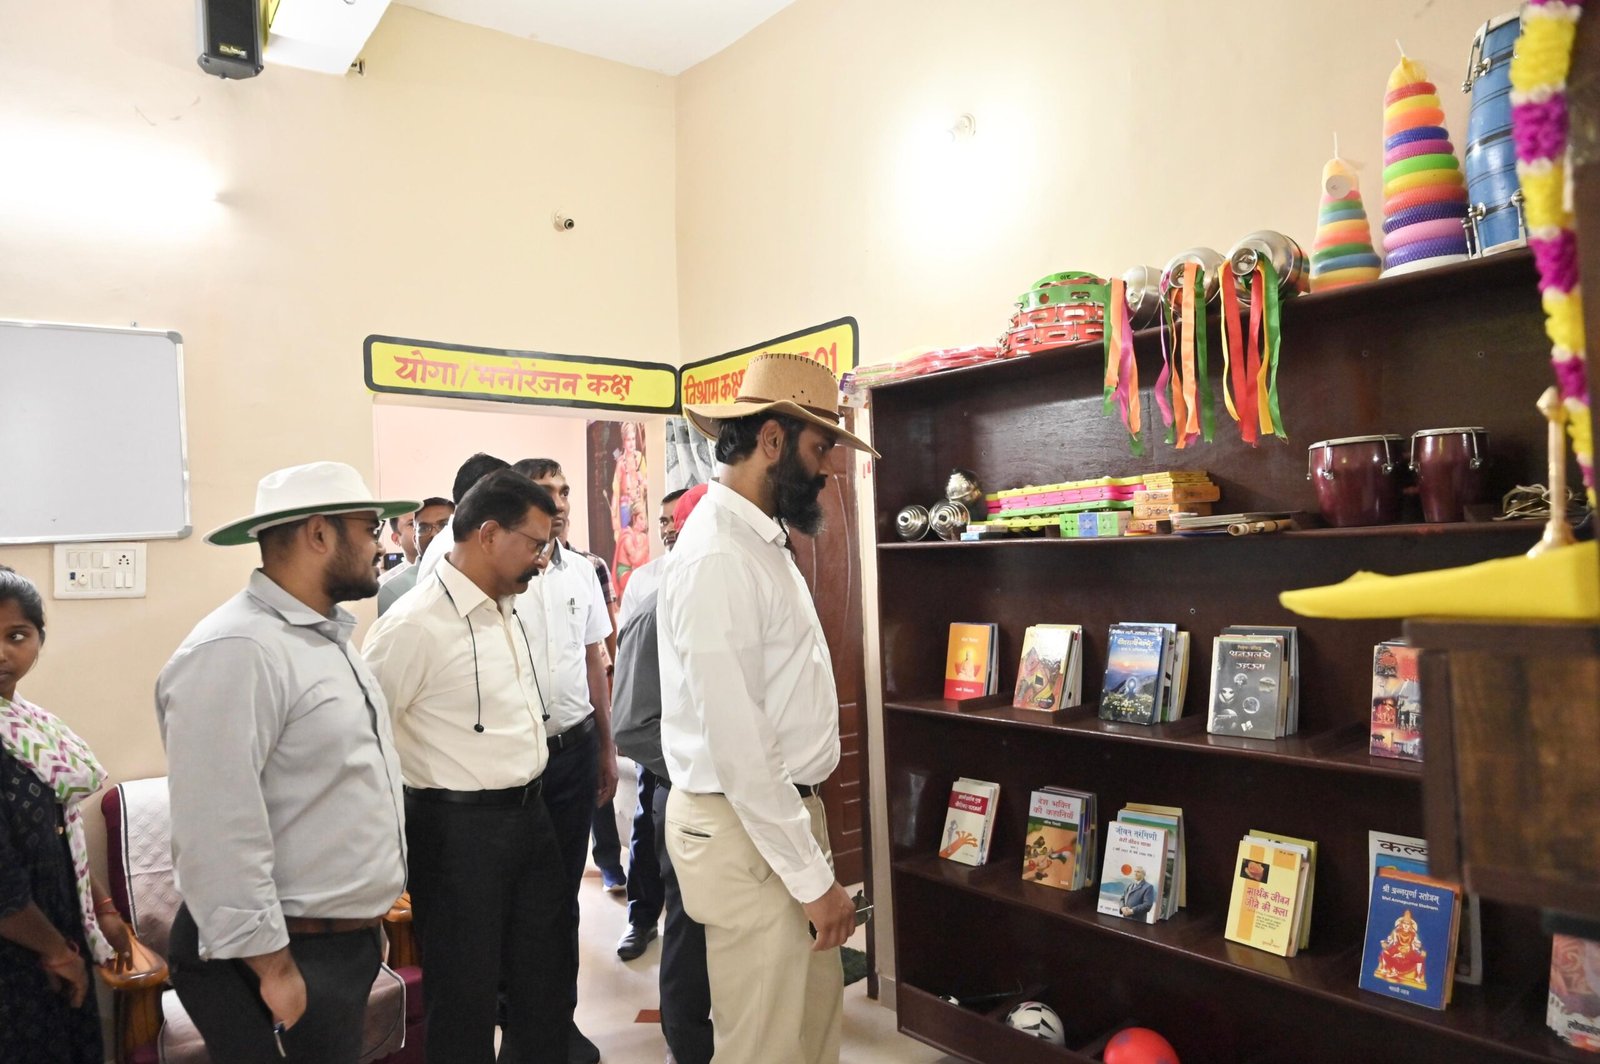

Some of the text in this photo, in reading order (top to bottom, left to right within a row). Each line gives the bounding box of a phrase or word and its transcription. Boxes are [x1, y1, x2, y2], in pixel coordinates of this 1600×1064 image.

[393, 349, 634, 401] योगा/मनोरंजन कक्ष
[1115, 825, 1132, 837] जीवन
[1246, 887, 1291, 906] सार्थक जीवन
[1382, 883, 1390, 893] श्री
[1262, 901, 1271, 912] की
[1273, 905, 1289, 918] कला
